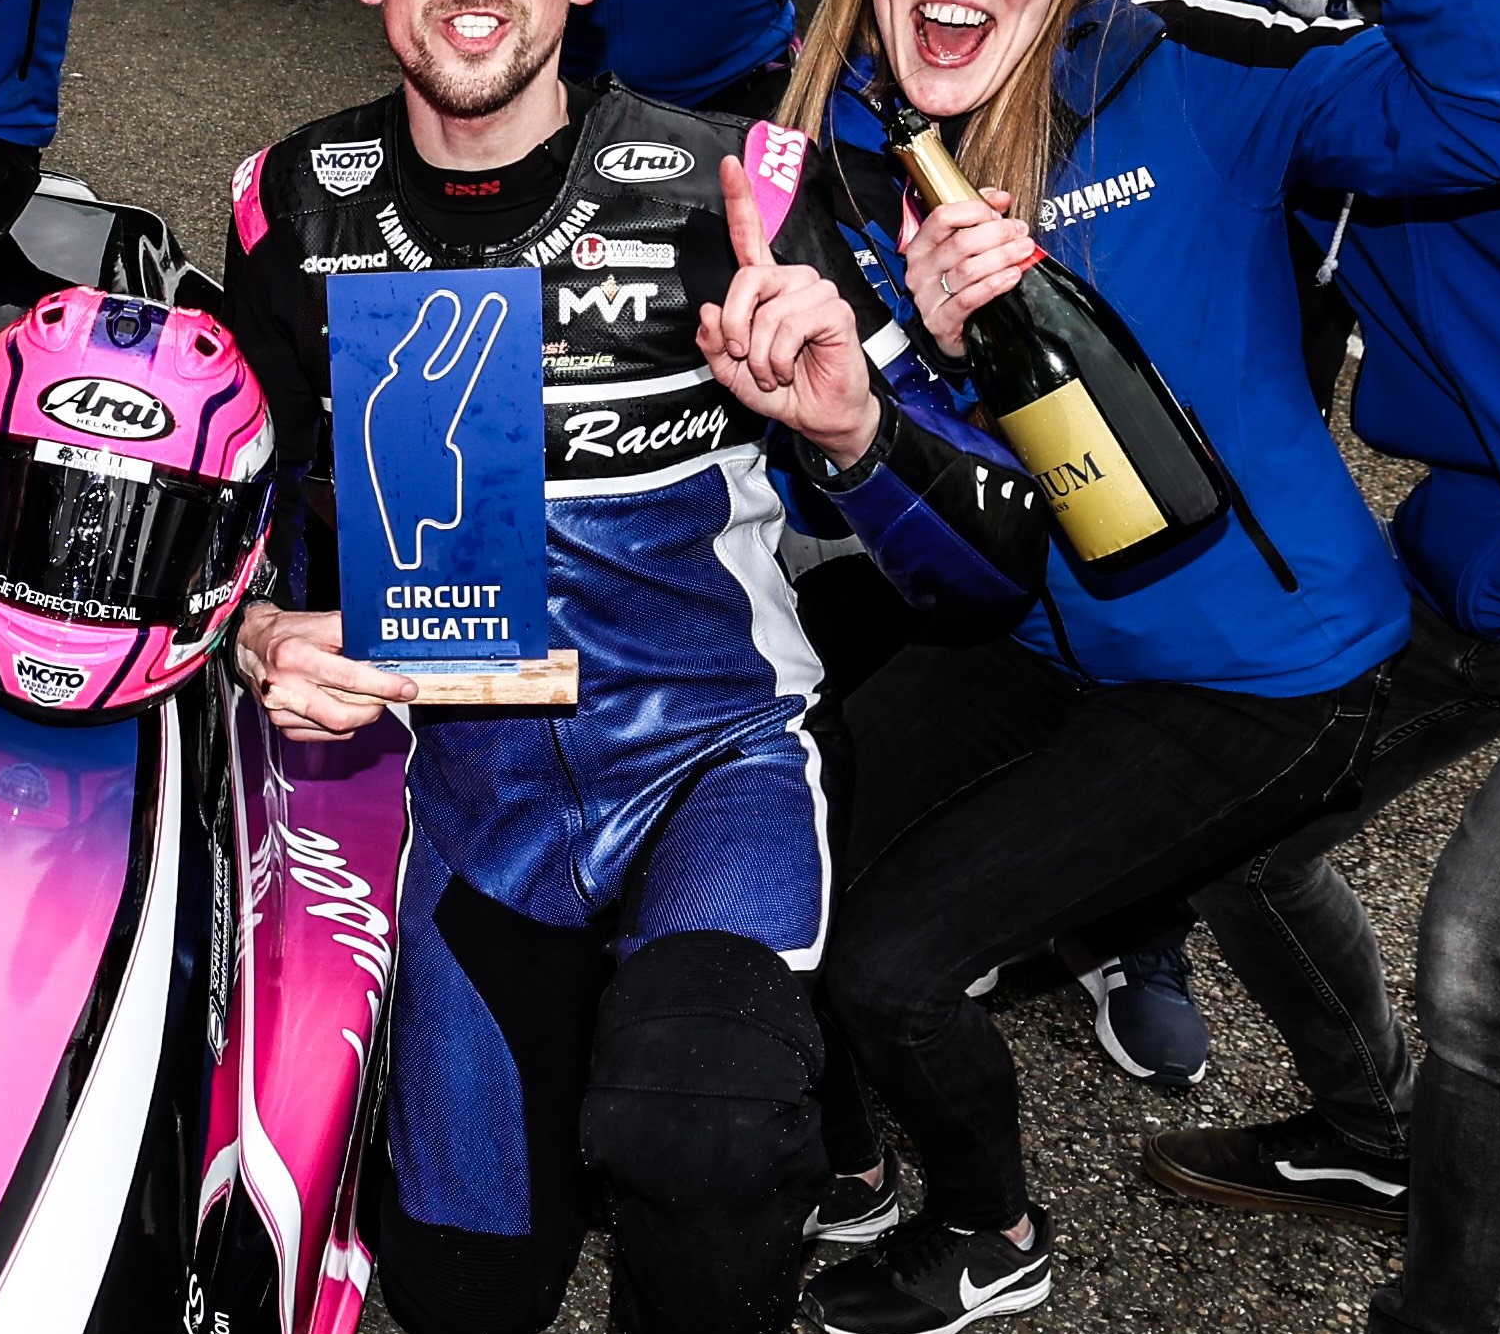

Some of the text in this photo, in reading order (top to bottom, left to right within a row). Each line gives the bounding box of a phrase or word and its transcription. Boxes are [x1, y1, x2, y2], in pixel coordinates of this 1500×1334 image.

[316, 150, 381, 168] MOTO
[601, 146, 680, 173] Arai
[1054, 166, 1156, 216] YAMAHA
[1044, 191, 1151, 231] RACING
[375, 203, 433, 273] YAMAHA
[522, 199, 600, 267] YAMAHA
[542, 352, 614, 371] nergie
[43, 381, 163, 430] Arai
[563, 405, 729, 462] Racing
[1037, 451, 1106, 499] IUM
[15, 583, 84, 616] PERFECT
[83, 600, 142, 622] DETAIL
[386, 585, 501, 608] CIRCUIT
[381, 618, 509, 640] BUGATTI
[17, 661, 84, 688] MOTO
